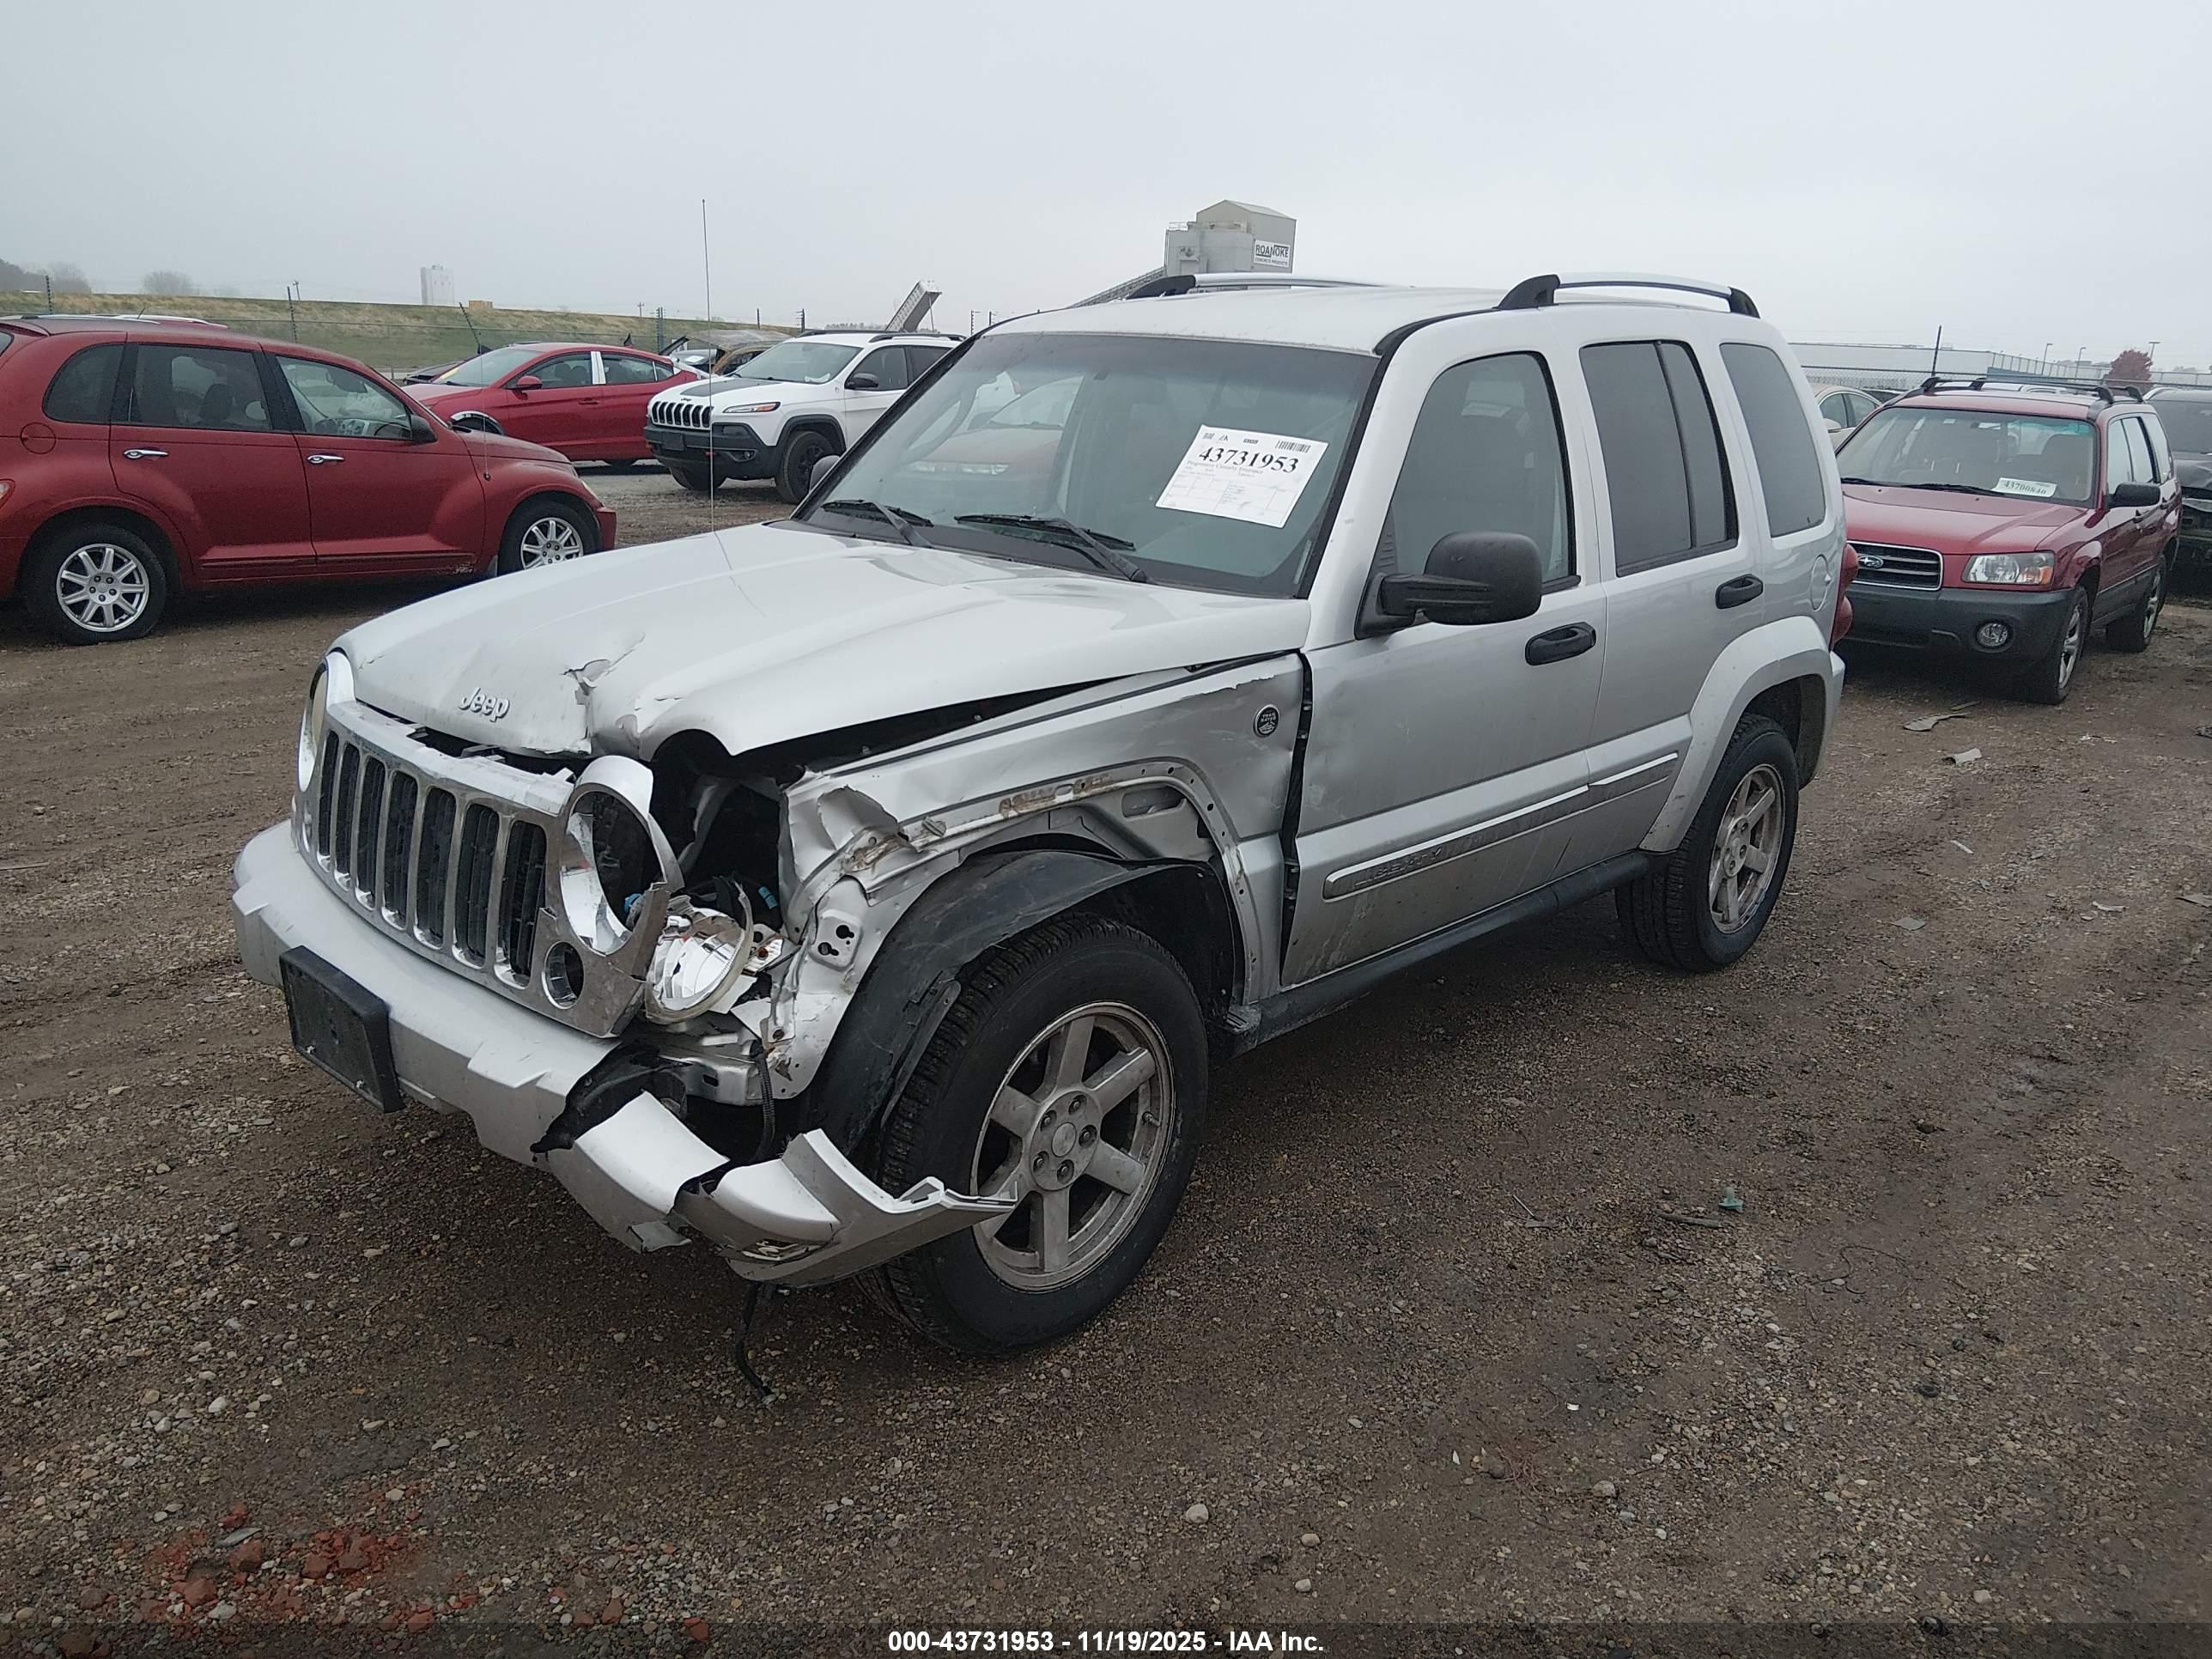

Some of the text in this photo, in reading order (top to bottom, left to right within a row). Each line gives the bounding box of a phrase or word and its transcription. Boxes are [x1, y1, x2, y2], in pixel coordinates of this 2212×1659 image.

[1255, 244, 1289, 258] ROANOKE
[1199, 446, 1299, 473] 43731953
[459, 687, 510, 723] Jeep
